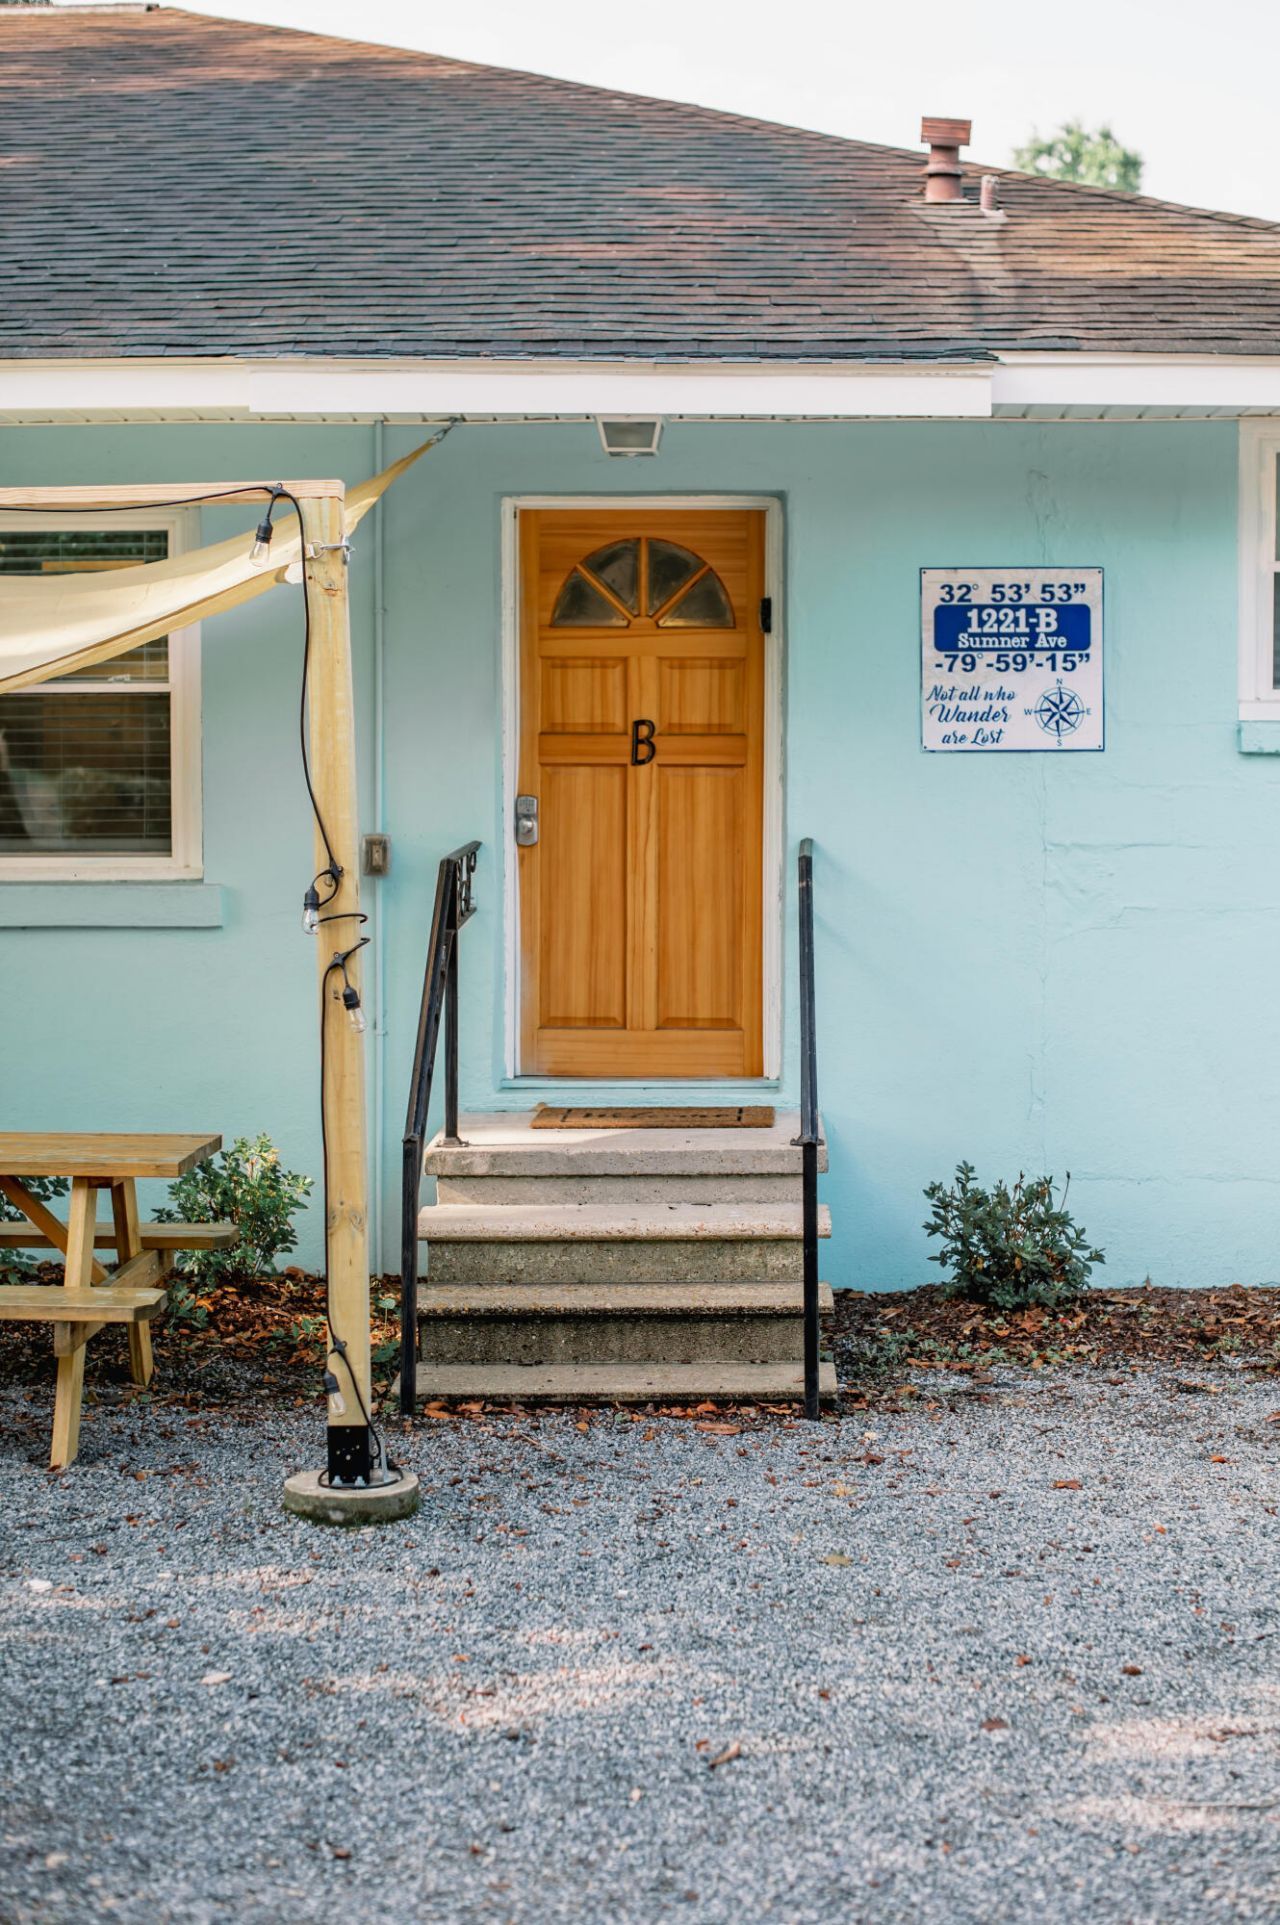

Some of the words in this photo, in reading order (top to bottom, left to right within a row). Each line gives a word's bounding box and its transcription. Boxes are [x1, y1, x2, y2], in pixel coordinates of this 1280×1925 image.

[939, 583, 979, 603] 32°
[967, 608, 1058, 633] 1221-B
[958, 633, 1029, 648] Sumner
[1035, 633, 1067, 648] Ave
[926, 685, 958, 701] Not
[959, 686, 980, 701] all
[984, 686, 1015, 701] who
[929, 703, 1010, 723] Wander
[631, 719, 656, 766] B
[942, 733, 967, 744] are
[971, 728, 1004, 746] Lost
